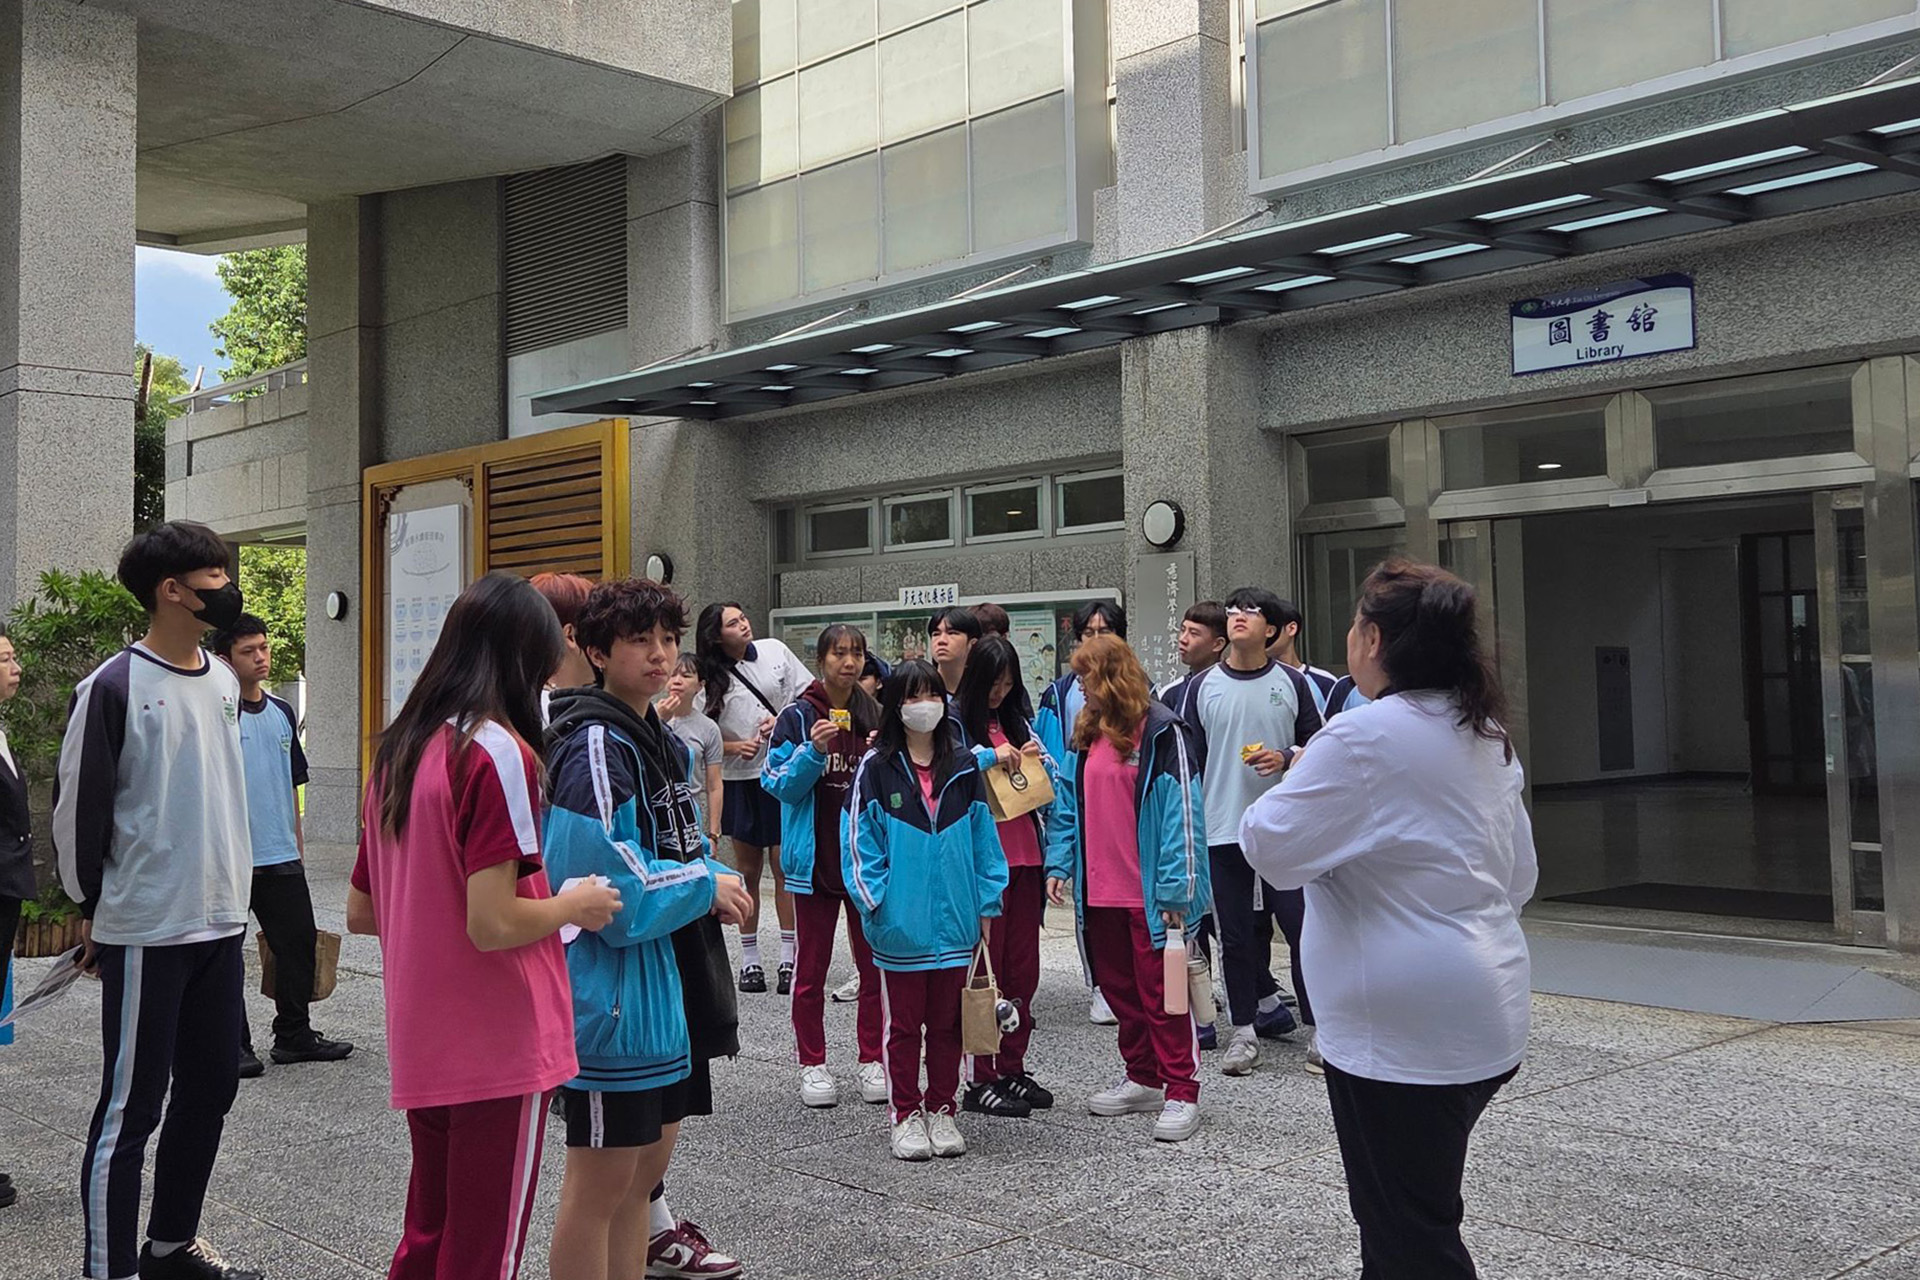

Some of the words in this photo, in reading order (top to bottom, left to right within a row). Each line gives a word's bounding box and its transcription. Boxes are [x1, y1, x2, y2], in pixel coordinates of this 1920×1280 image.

[1549, 303, 1658, 346] 圖書館
[1577, 344, 1625, 361] Library
[903, 587, 954, 606] 多元文化展示區
